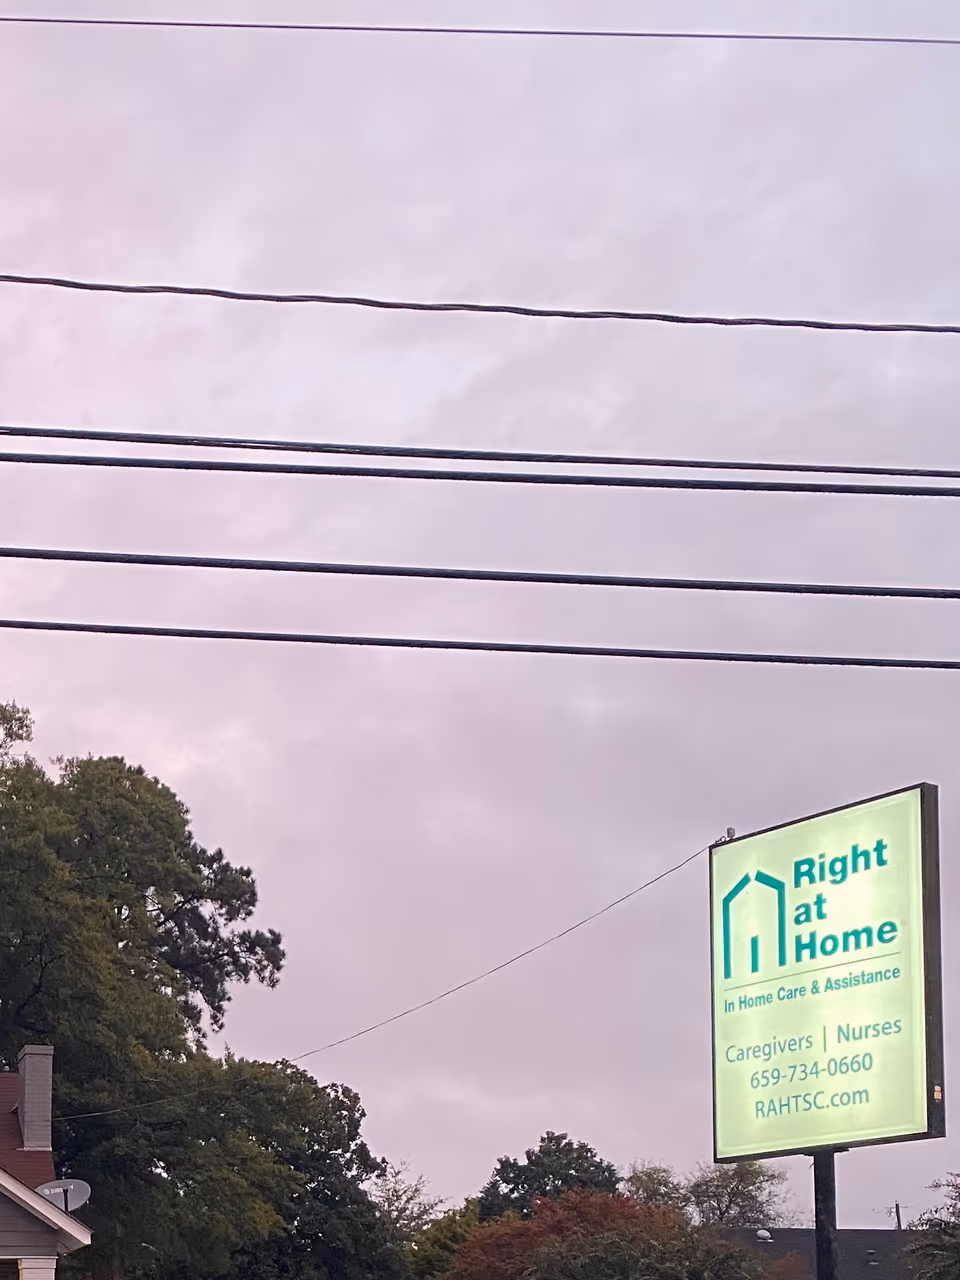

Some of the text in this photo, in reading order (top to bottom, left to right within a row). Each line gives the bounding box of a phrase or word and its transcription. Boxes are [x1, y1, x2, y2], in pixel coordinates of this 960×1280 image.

[794, 838, 888, 888] Right
[794, 893, 827, 925] at
[795, 921, 898, 963] Home
[724, 967, 901, 1013] In Home Care & Assistance
[725, 1034, 813, 1063] Caregivers
[837, 1018, 902, 1044] Nurses
[750, 1052, 873, 1089] 659-734-0660
[755, 1088, 870, 1119] RAHTSC.com
